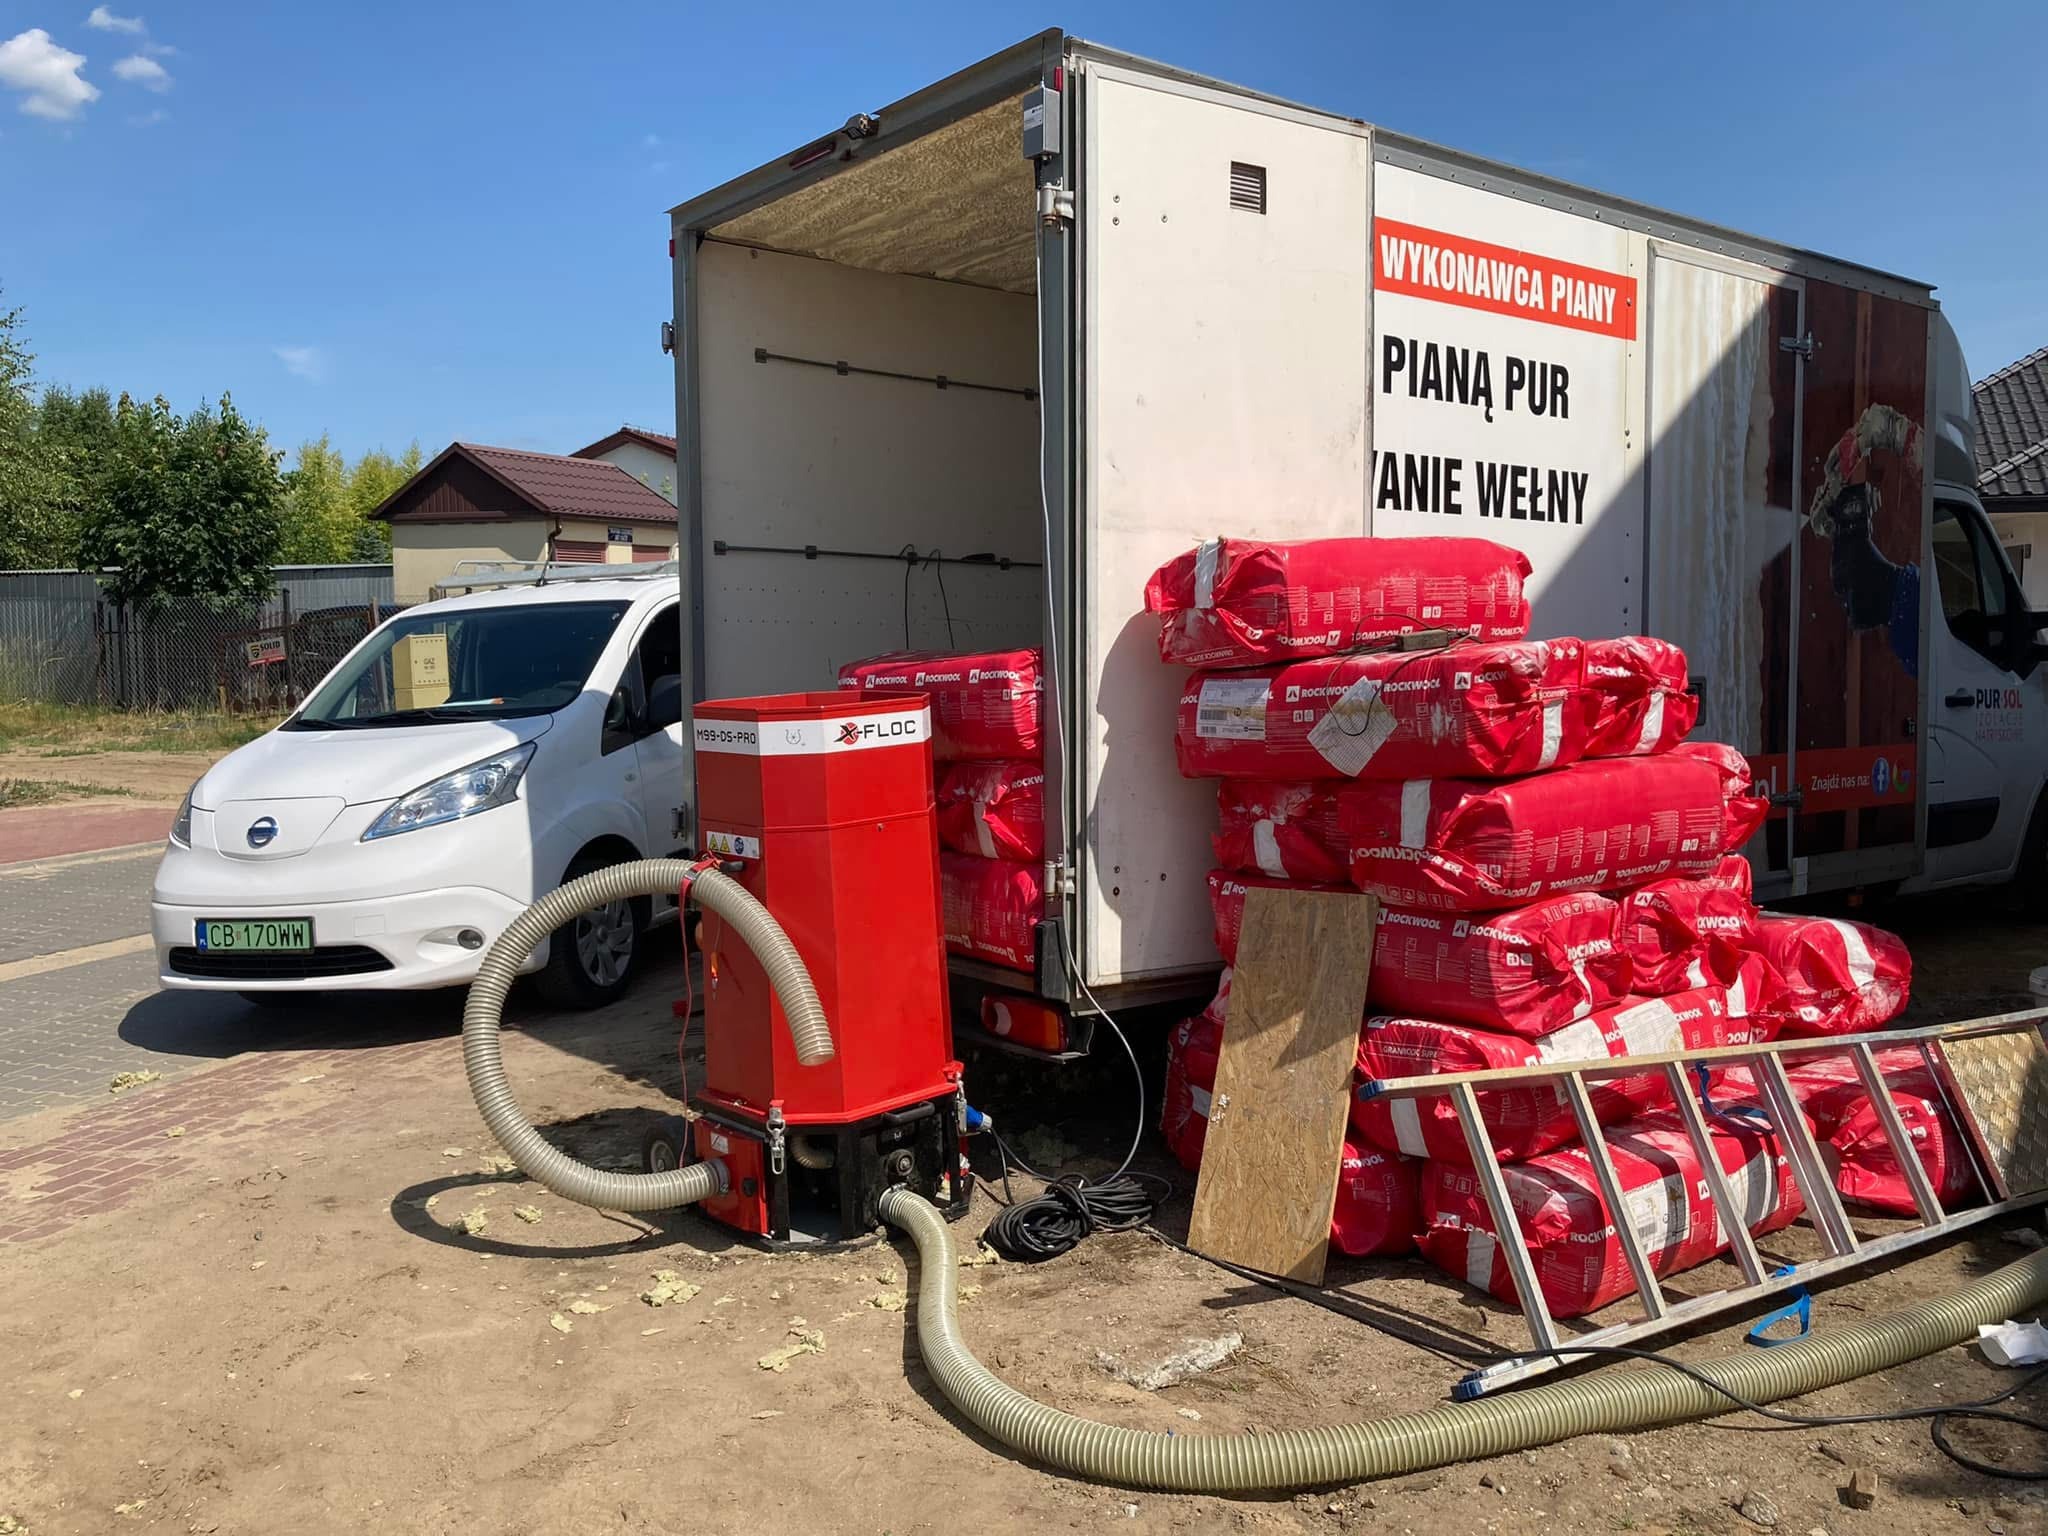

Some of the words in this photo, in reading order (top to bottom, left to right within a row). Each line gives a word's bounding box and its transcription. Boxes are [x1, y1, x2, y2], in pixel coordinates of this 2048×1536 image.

[1380, 234, 1545, 310] WYKONAWCA
[1551, 273, 1617, 325] PIANY
[1382, 334, 1494, 424] PIANĄ
[1505, 355, 1570, 419] PUR
[1373, 449, 1463, 516] ANIE
[1475, 461, 1589, 525] WEŁNY
[260, 640, 281, 651] SOLID
[875, 675, 907, 686] ROCKWOOL
[925, 673, 961, 683] ROCKWOOL
[979, 670, 1021, 681] ROCKWOOL
[1383, 677, 1441, 693] ROCKWOOL
[696, 728, 757, 745] M99-DS-PRO
[834, 720, 917, 745] X-FLOC
[1841, 776, 1856, 789] nas
[1387, 912, 1442, 931] ROCKWOOL
[210, 924, 236, 947] CB
[243, 923, 304, 948] 170WW
